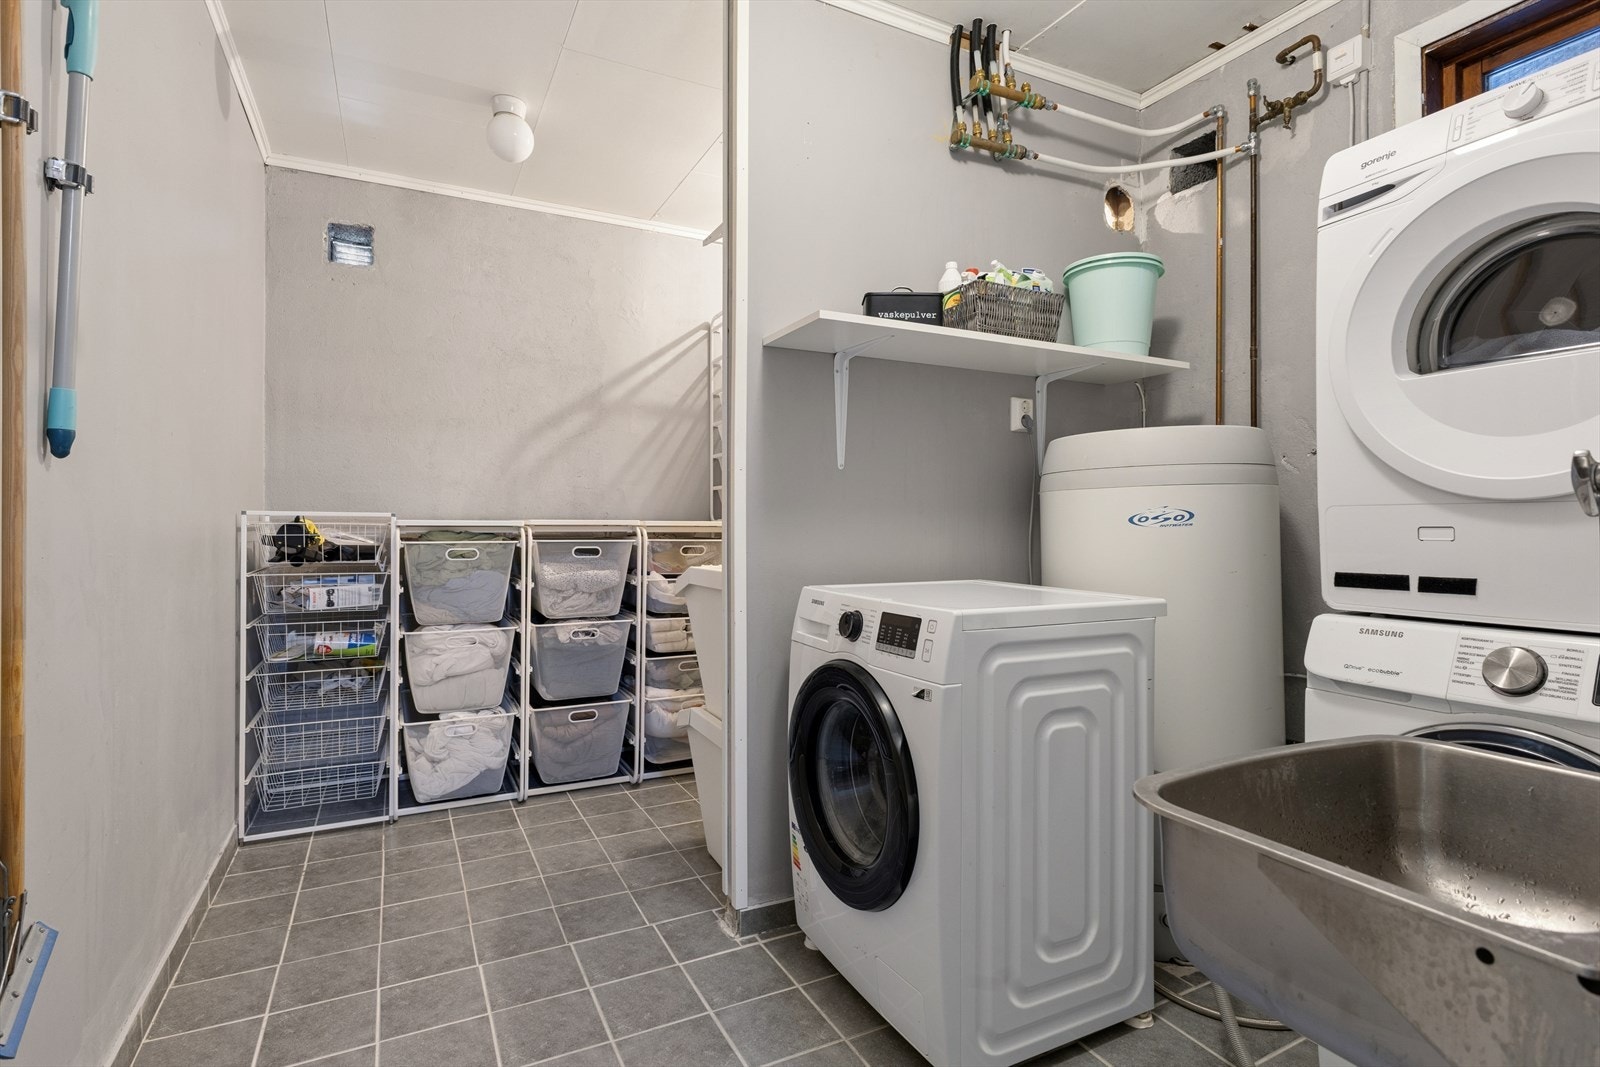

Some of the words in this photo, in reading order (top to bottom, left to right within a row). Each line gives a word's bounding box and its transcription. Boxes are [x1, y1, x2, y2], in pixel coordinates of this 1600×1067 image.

[1360, 150, 1397, 170] gorenje
[878, 311, 937, 320] vaskepulver
[1359, 627, 1404, 638] SAMSUNG
